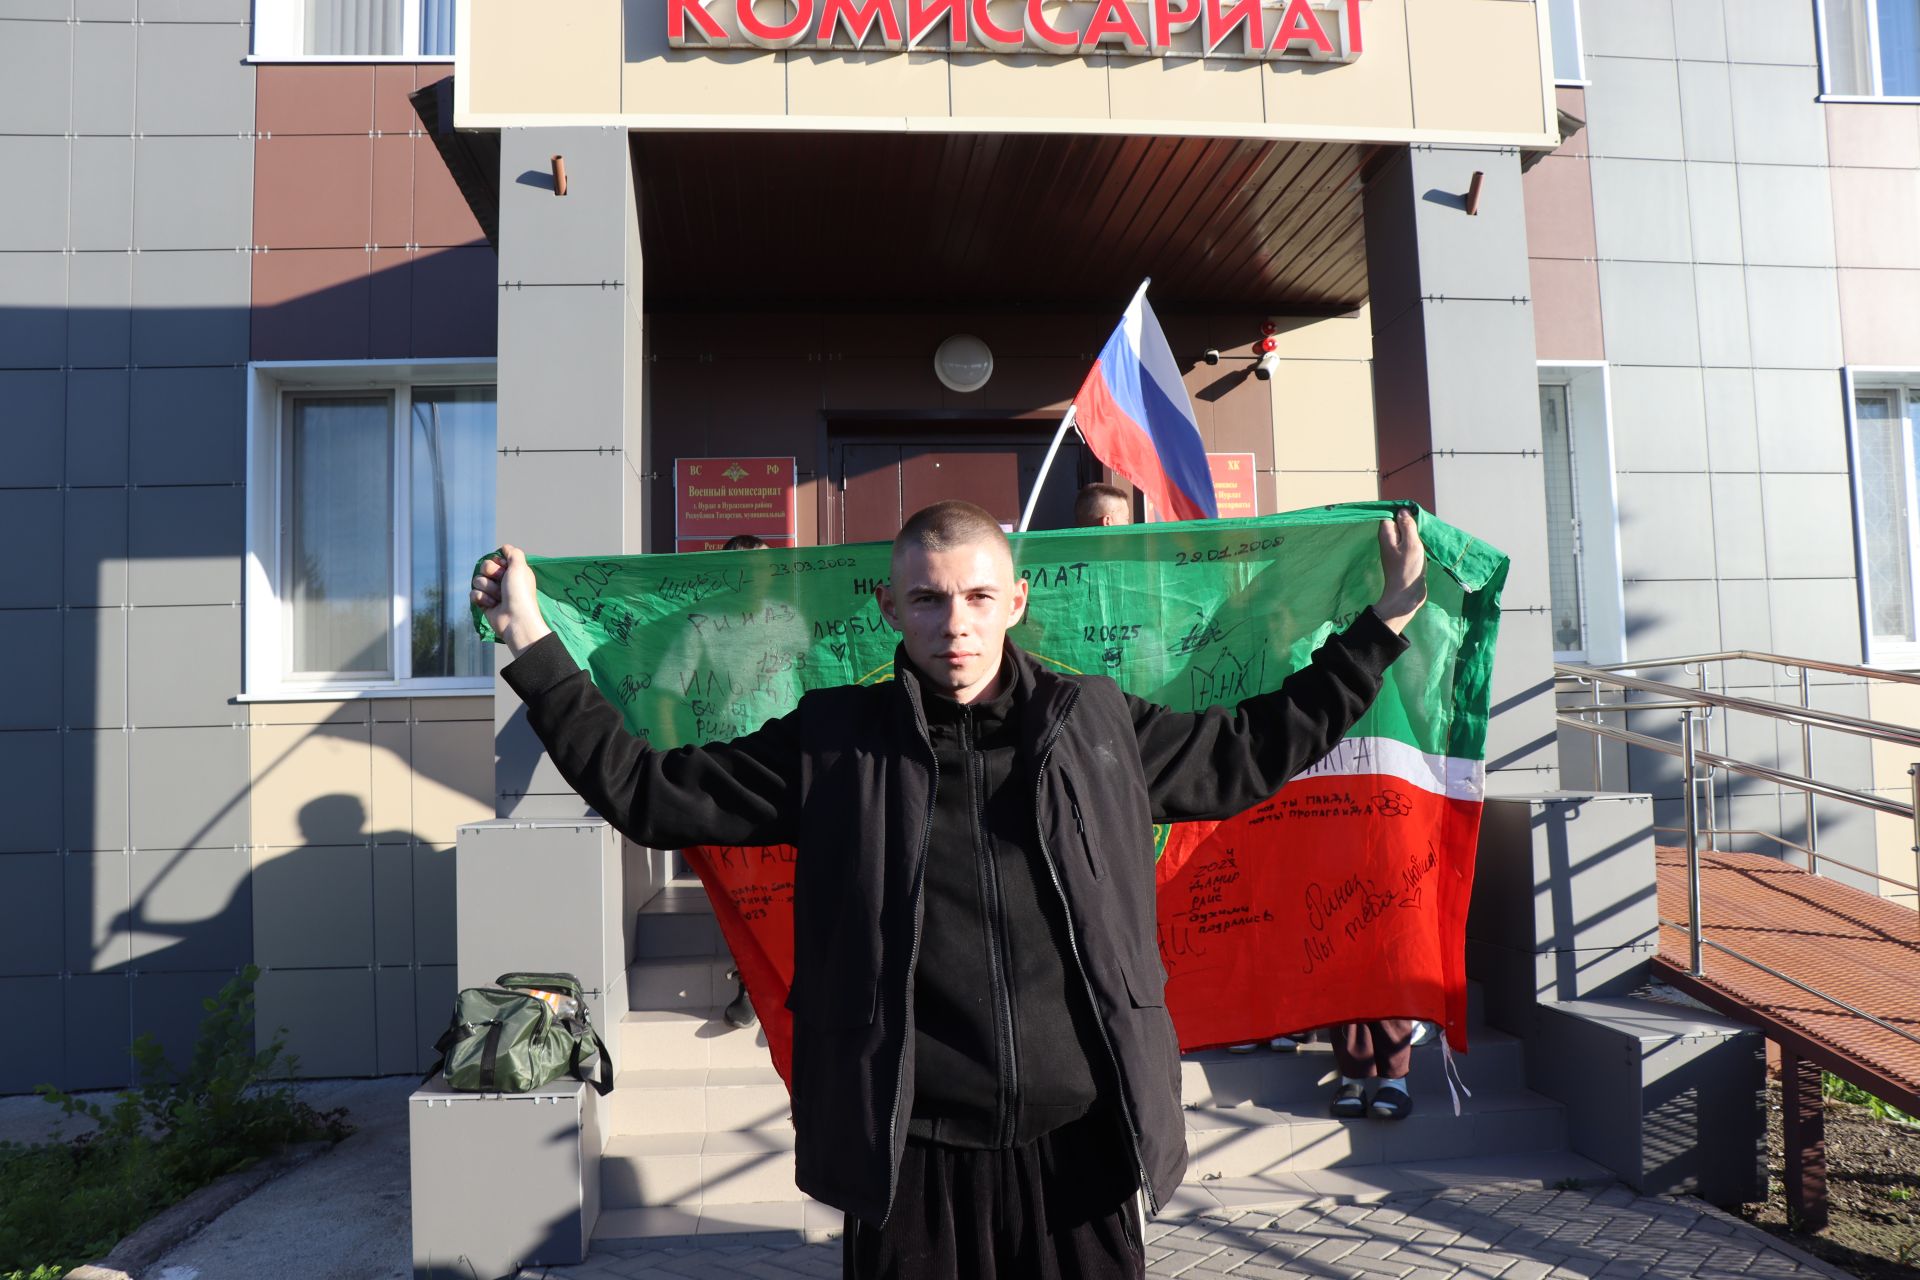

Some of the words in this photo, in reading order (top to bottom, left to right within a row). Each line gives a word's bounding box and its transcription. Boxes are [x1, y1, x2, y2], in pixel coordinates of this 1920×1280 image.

[667, 0, 1363, 59] КОМИССАРИАТ
[690, 465, 702, 476] ВС
[767, 464, 780, 475] РФ
[688, 485, 726, 497] Военный
[728, 487, 782, 499] комиссариат
[768, 557, 856, 577] 23.03.2002
